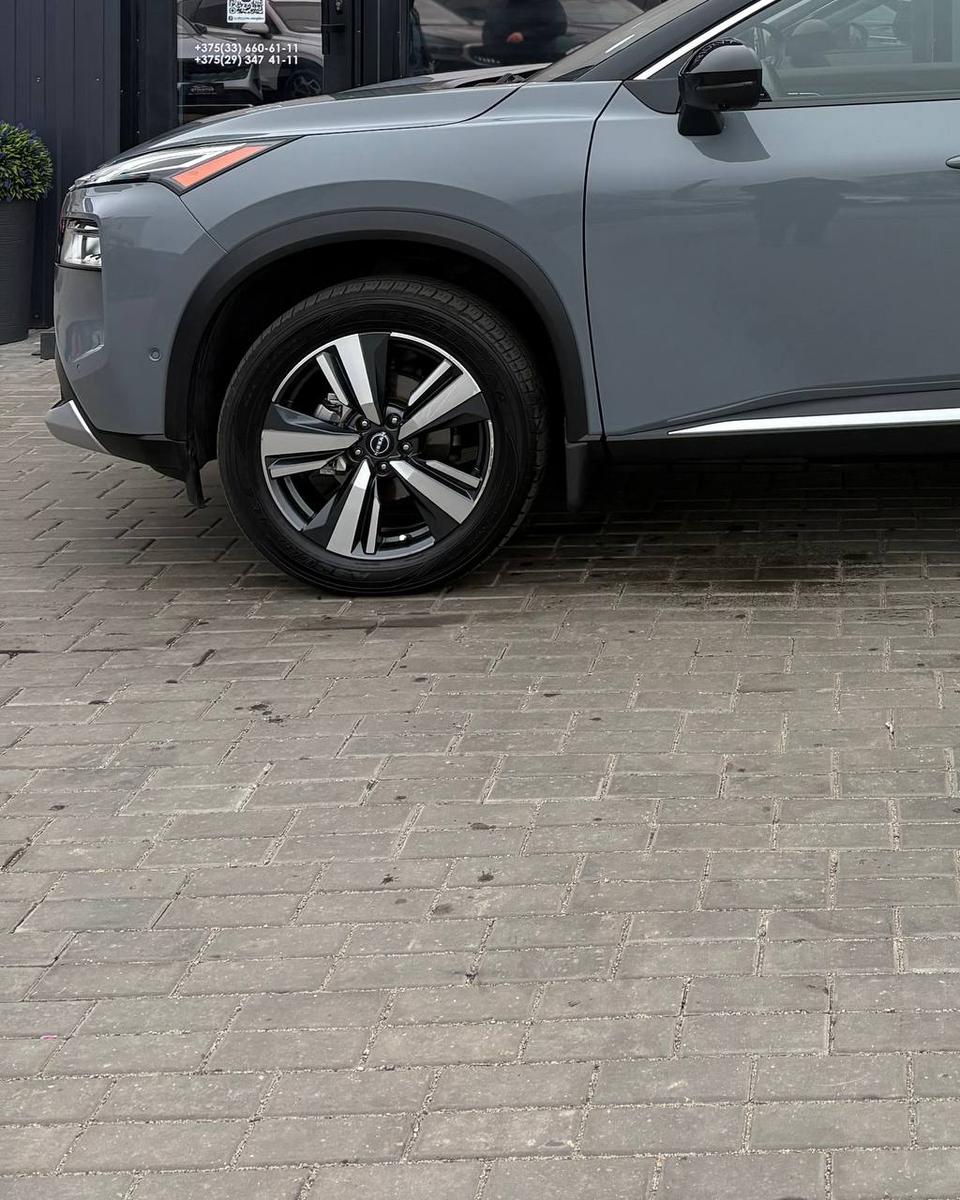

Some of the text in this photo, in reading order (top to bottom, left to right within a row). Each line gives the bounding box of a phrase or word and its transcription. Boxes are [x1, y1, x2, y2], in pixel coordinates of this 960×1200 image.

[194, 43, 299, 56] +375(33) 660-61-11
[194, 55, 242, 66] +375(29)
